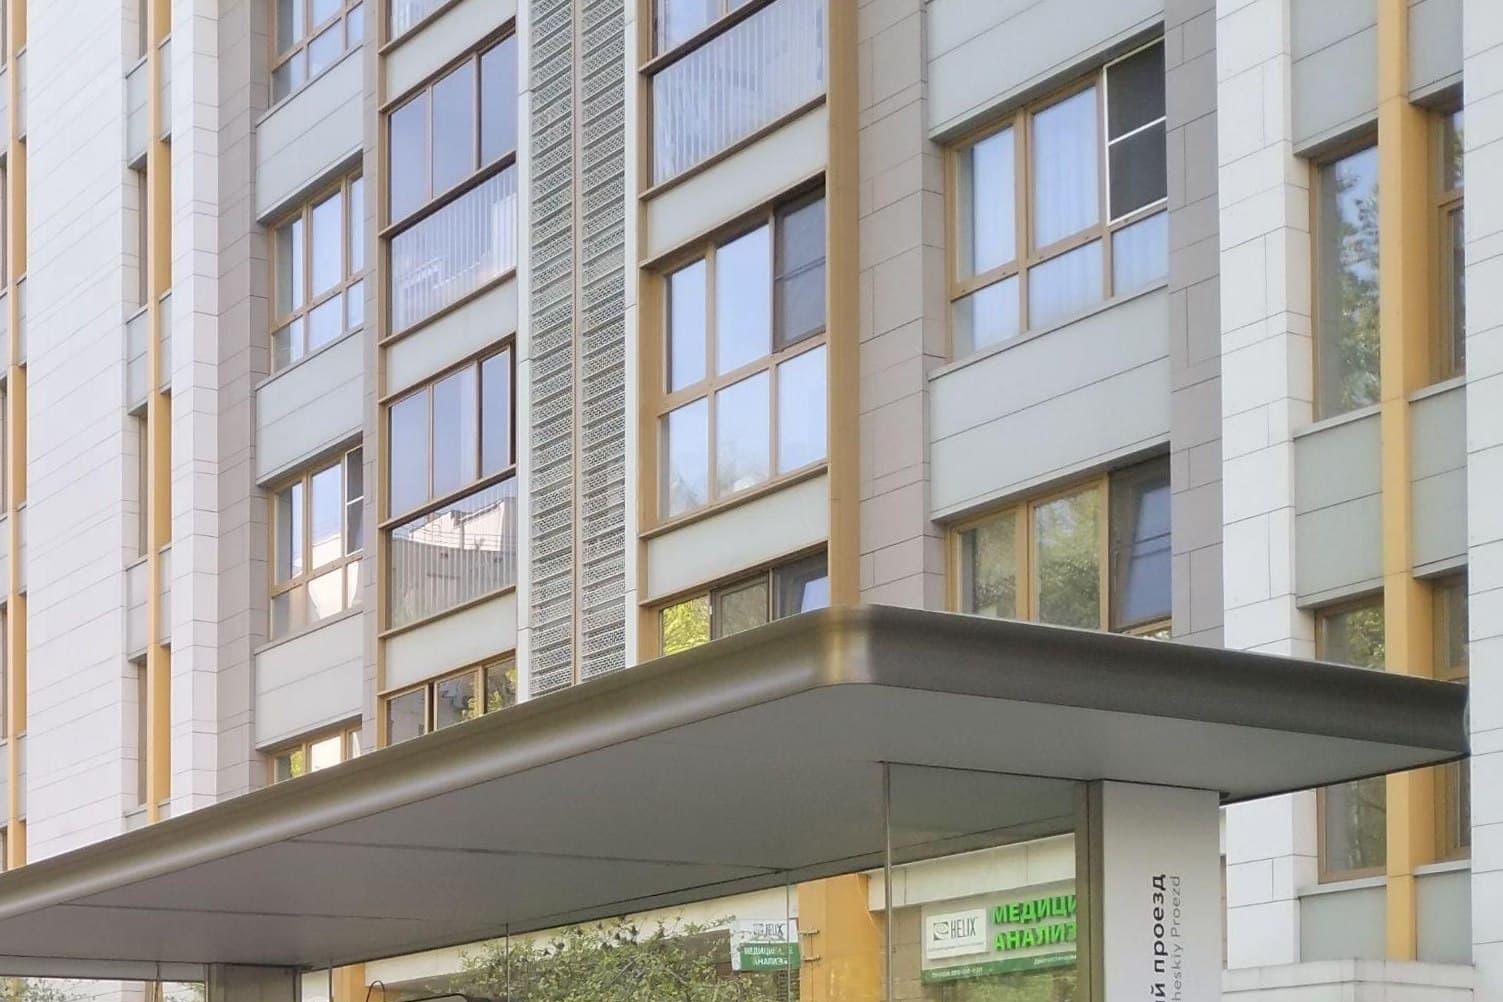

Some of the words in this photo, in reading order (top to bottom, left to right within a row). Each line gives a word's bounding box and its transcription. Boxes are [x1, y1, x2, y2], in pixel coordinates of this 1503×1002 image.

[950, 916, 977, 939] HELIX
[1152, 873, 1169, 973] проезд
[1169, 875, 1182, 937] Proezd
